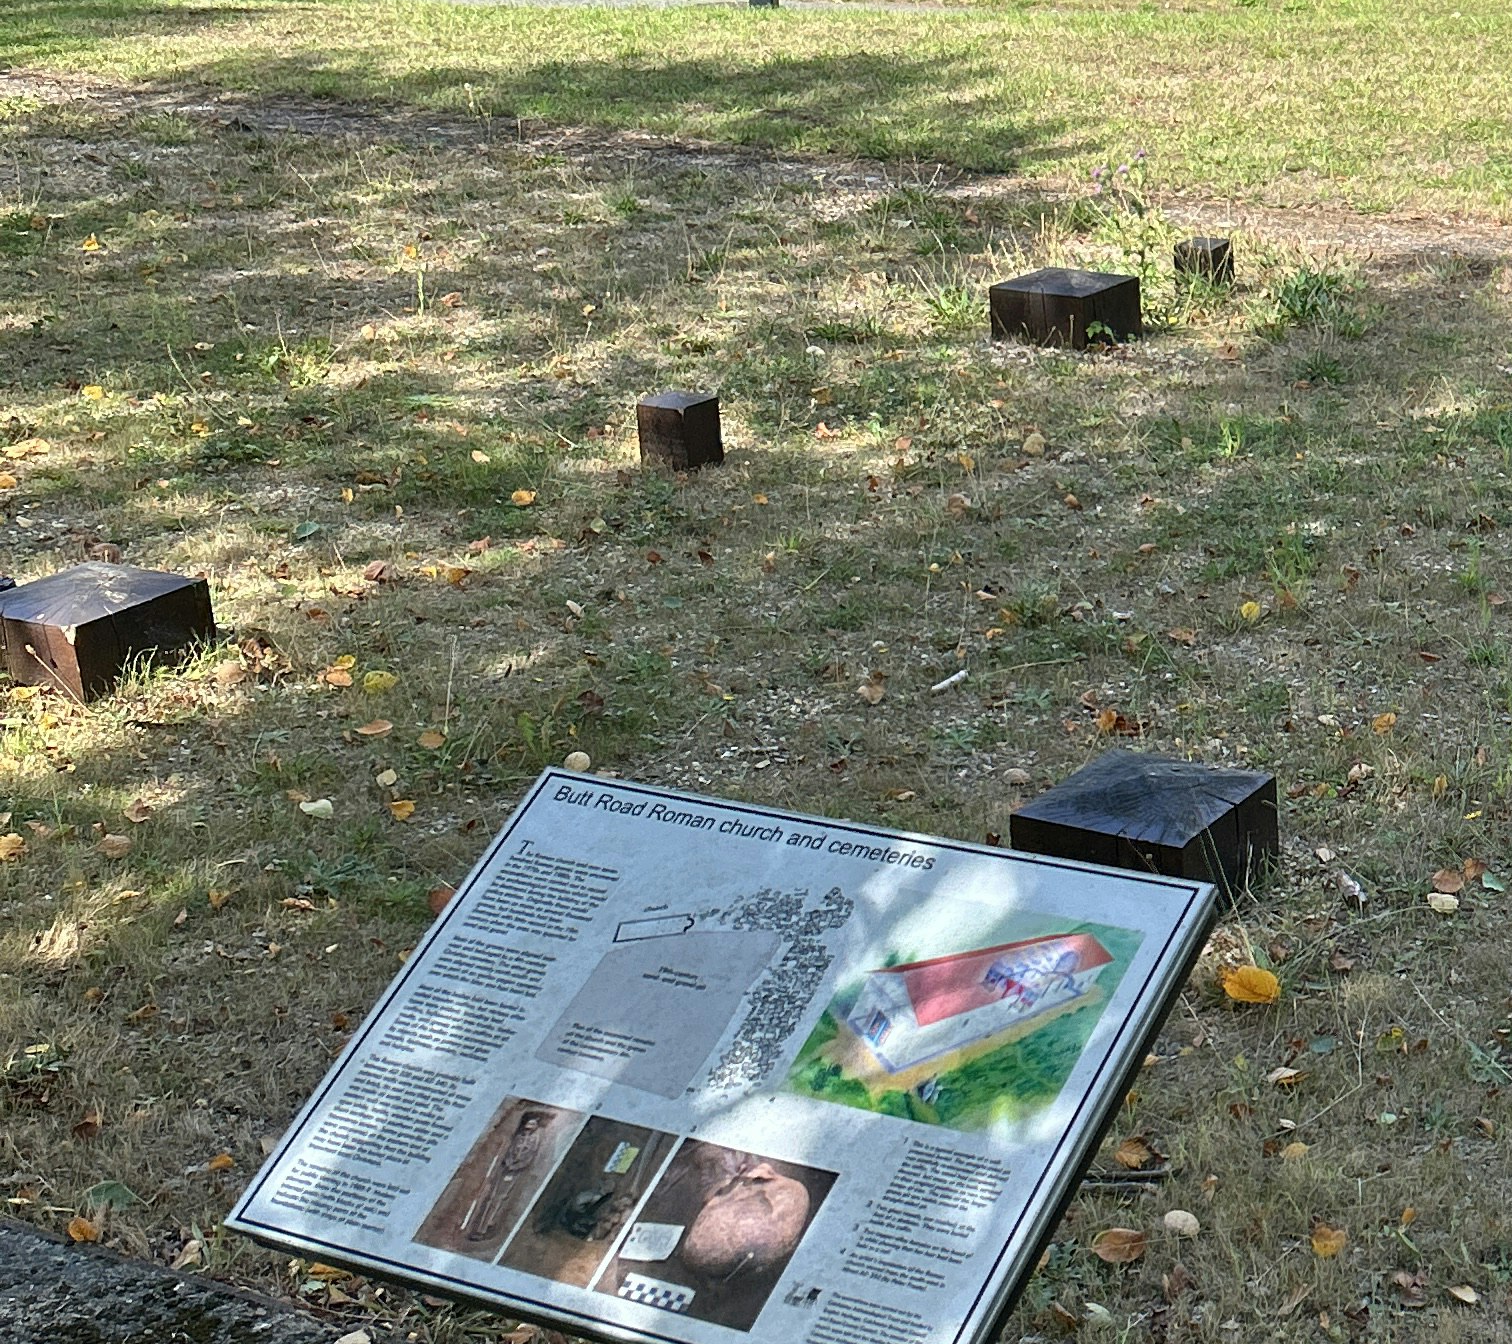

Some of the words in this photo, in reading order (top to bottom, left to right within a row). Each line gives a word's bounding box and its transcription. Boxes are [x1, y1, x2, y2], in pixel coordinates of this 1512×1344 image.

[554, 785, 594, 805] Butt
[595, 794, 648, 817] Road
[648, 803, 716, 831] Roman
[719, 818, 784, 843] church
[786, 831, 828, 850] and
[828, 840, 937, 872] cemeteries
